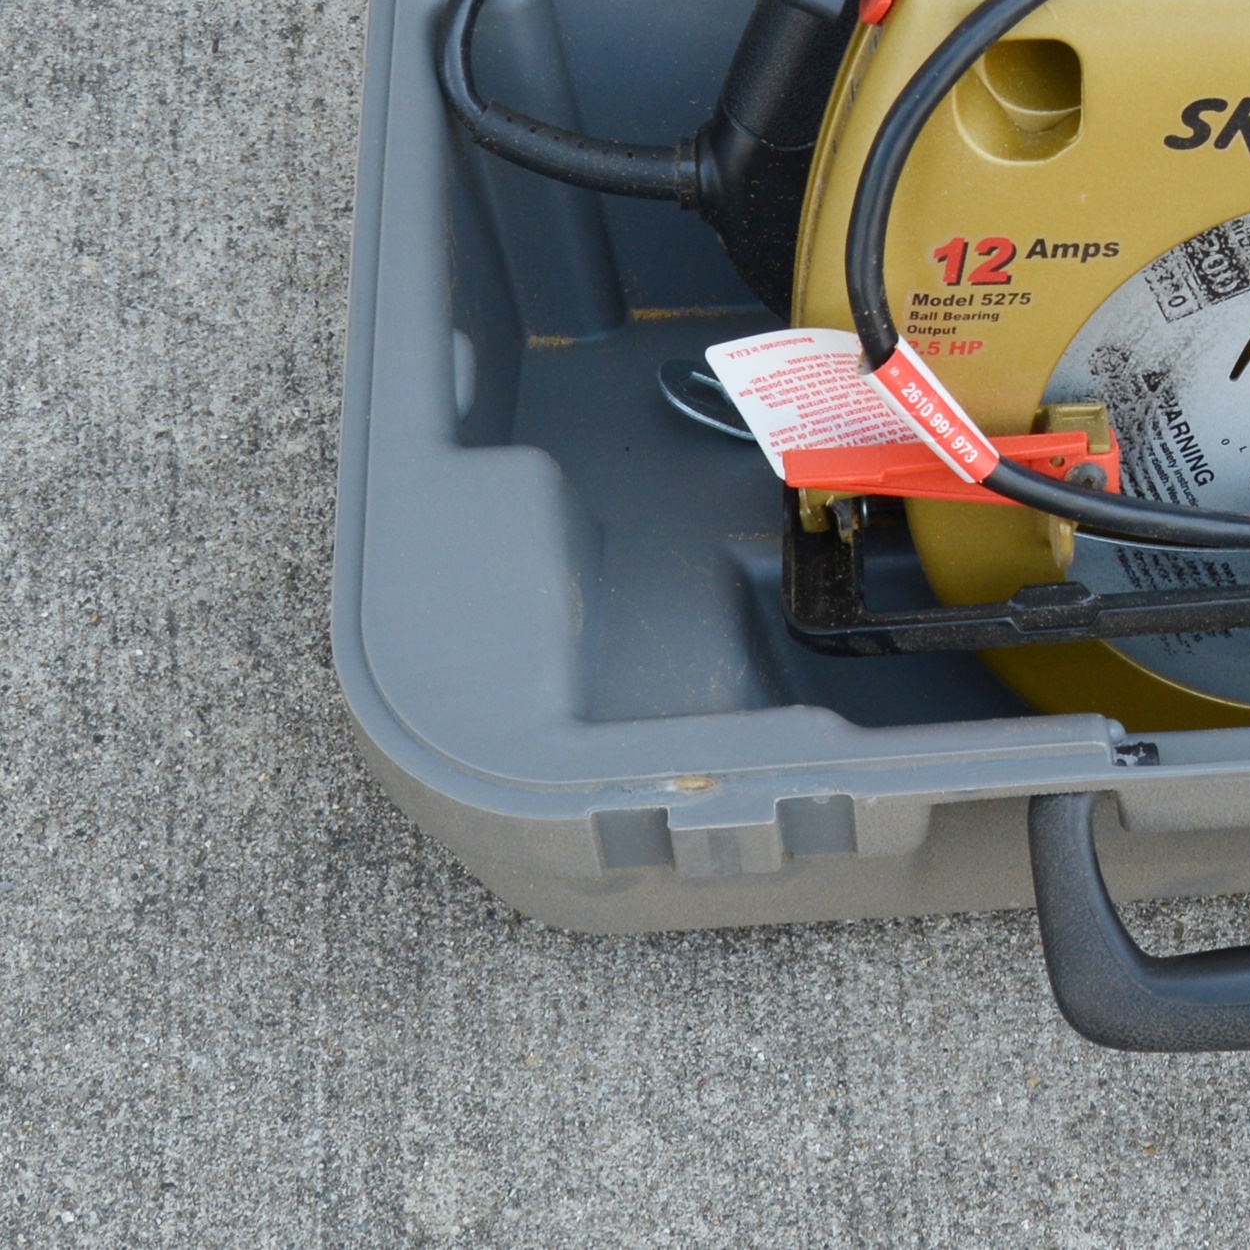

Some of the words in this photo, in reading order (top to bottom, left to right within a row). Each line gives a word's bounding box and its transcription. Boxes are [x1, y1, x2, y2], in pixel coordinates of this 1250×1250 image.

[933, 236, 1017, 287] 12
[1025, 238, 1120, 264] Amps
[911, 293, 974, 307] Model
[981, 292, 1032, 307] 5275
[909, 311, 938, 321] Ball
[943, 311, 1001, 323] Bearing
[906, 324, 957, 337] Output
[948, 340, 984, 356] HP
[901, 382, 934, 418] 2610
[929, 413, 955, 439] 991
[951, 436, 978, 464] 973
[1160, 442, 1179, 469] safety
